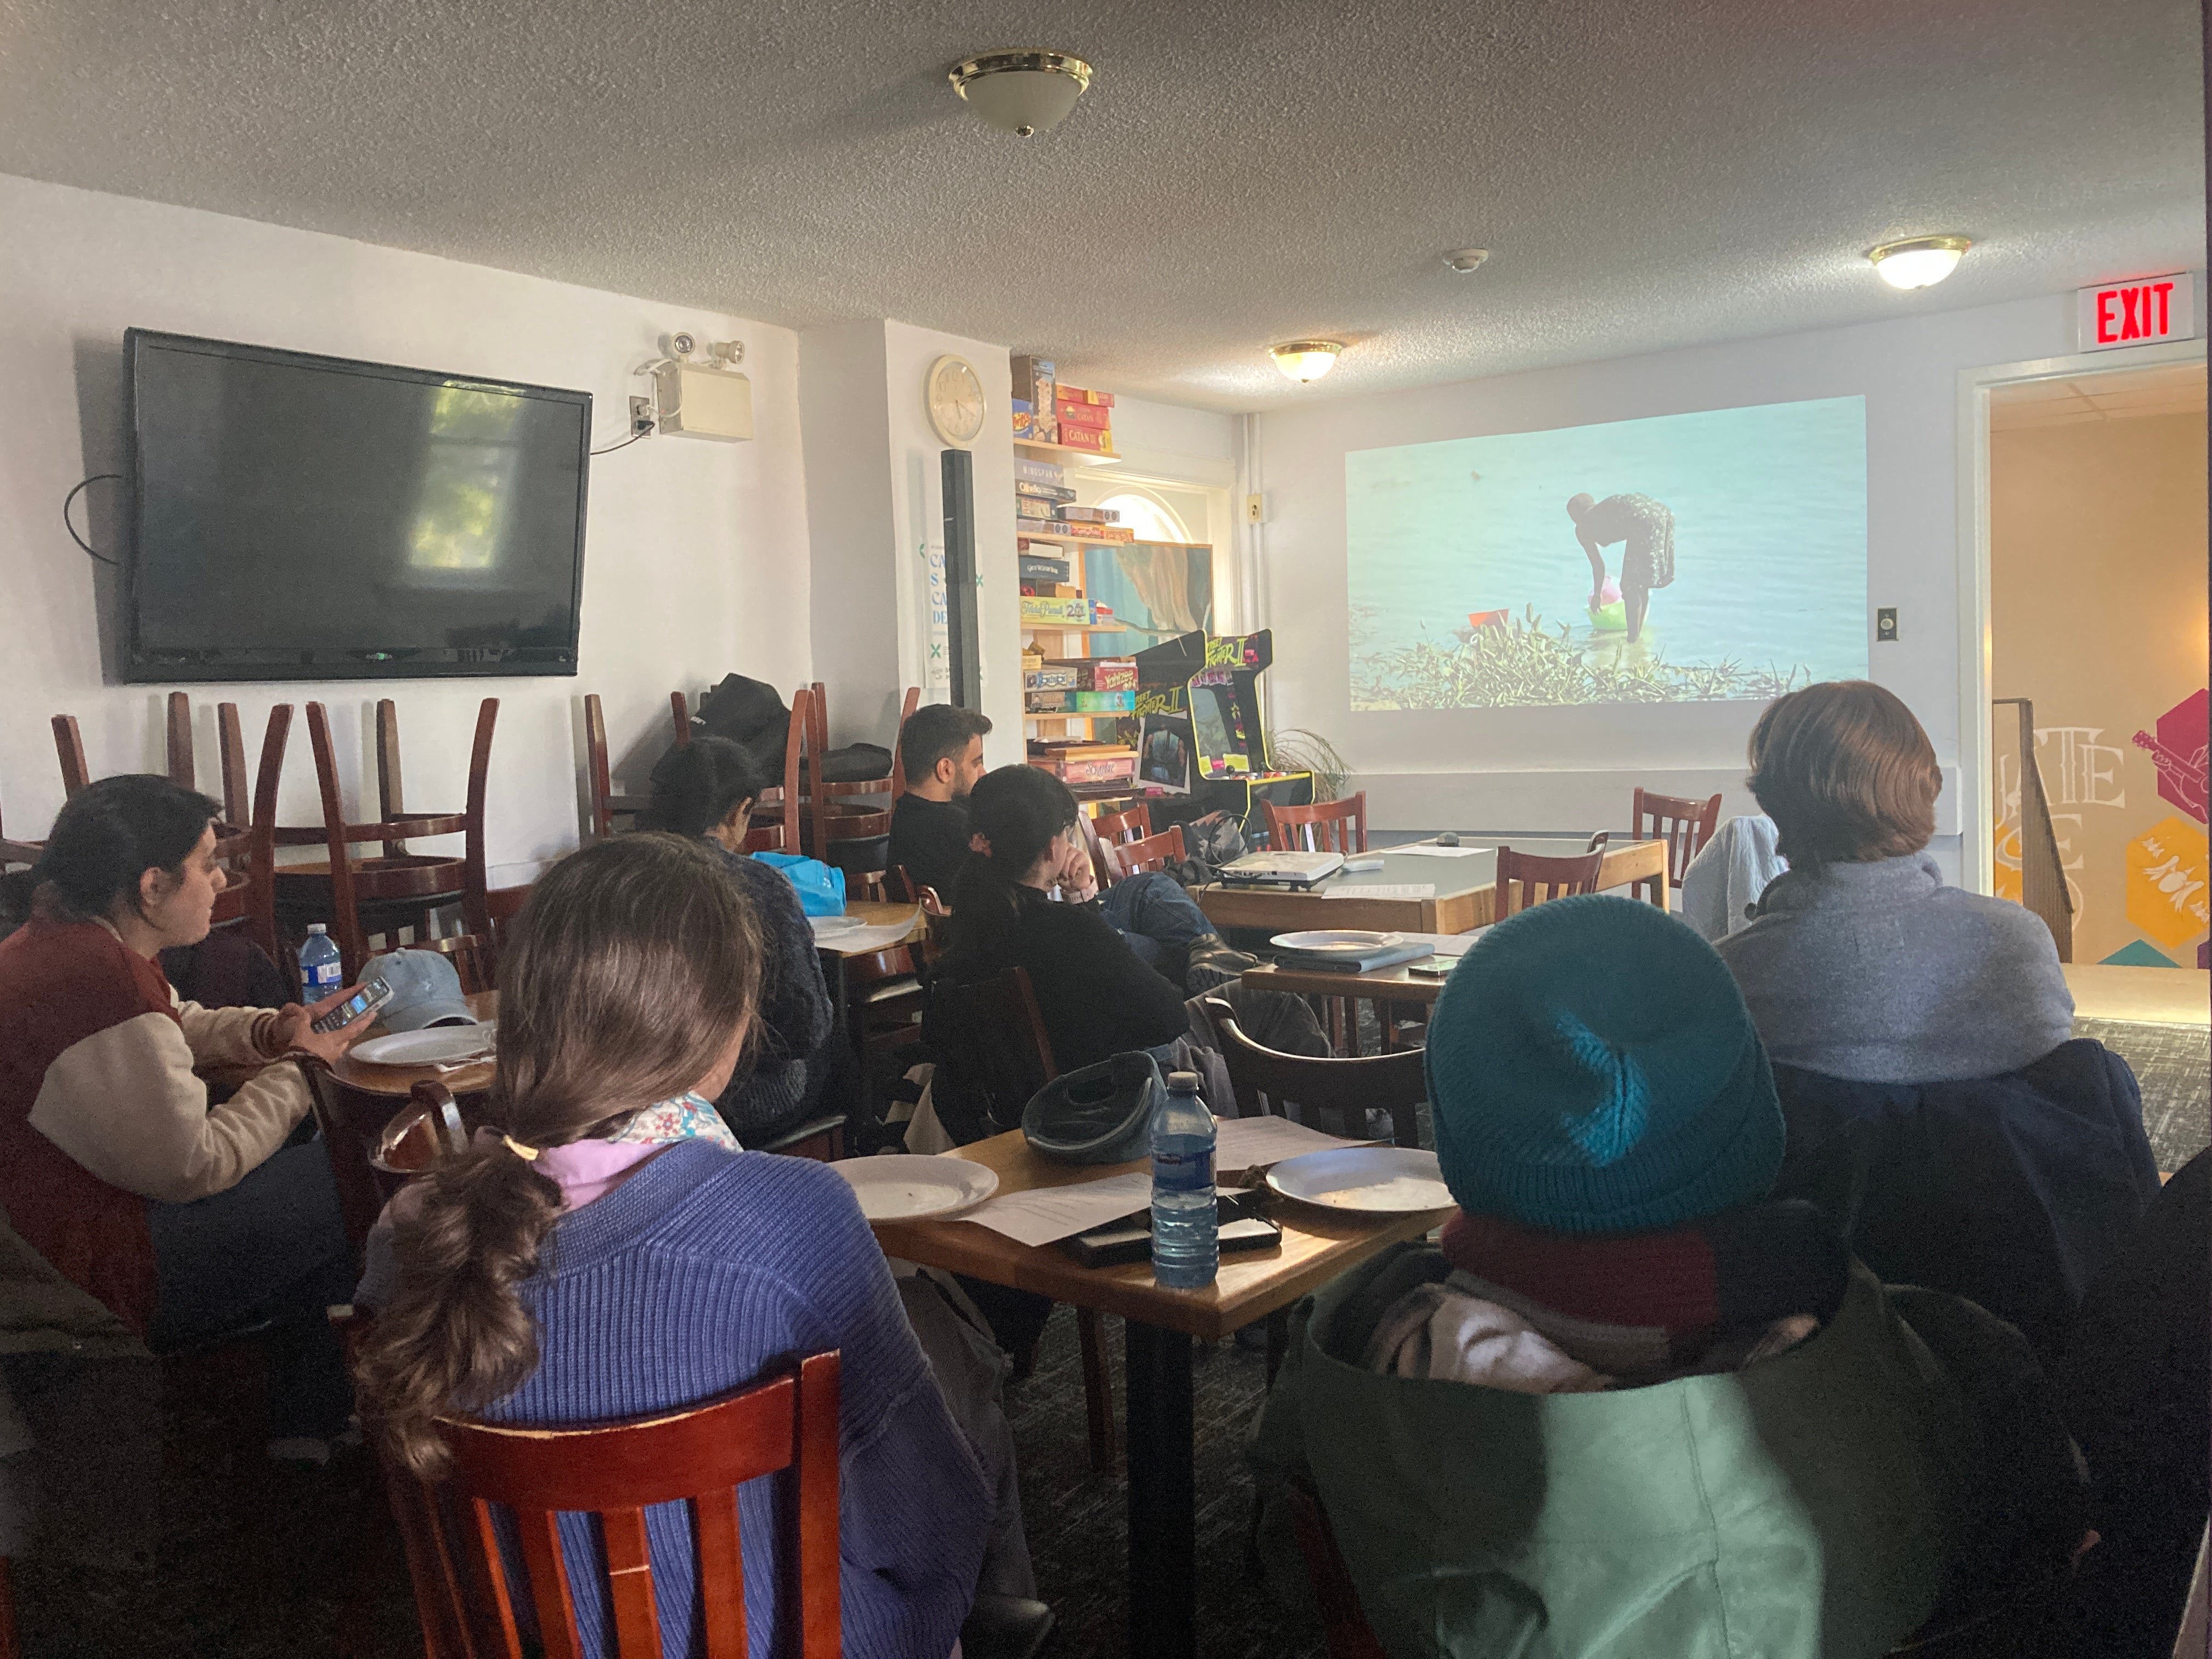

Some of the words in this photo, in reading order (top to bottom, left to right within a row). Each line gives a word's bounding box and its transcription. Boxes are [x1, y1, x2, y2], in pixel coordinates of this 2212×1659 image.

[2096, 281, 2174, 344] EXIT
[1077, 414, 1094, 422] CATAN
[1069, 430, 1090, 442] CATAN
[1023, 465, 1053, 479] WINGSPAN
[1019, 482, 1041, 494] Othello
[930, 554, 945, 567] CA
[932, 592, 947, 606] CA
[933, 611, 947, 624] DE
[1104, 670, 1133, 689] Yahtzee
[1135, 690, 1151, 706] REET
